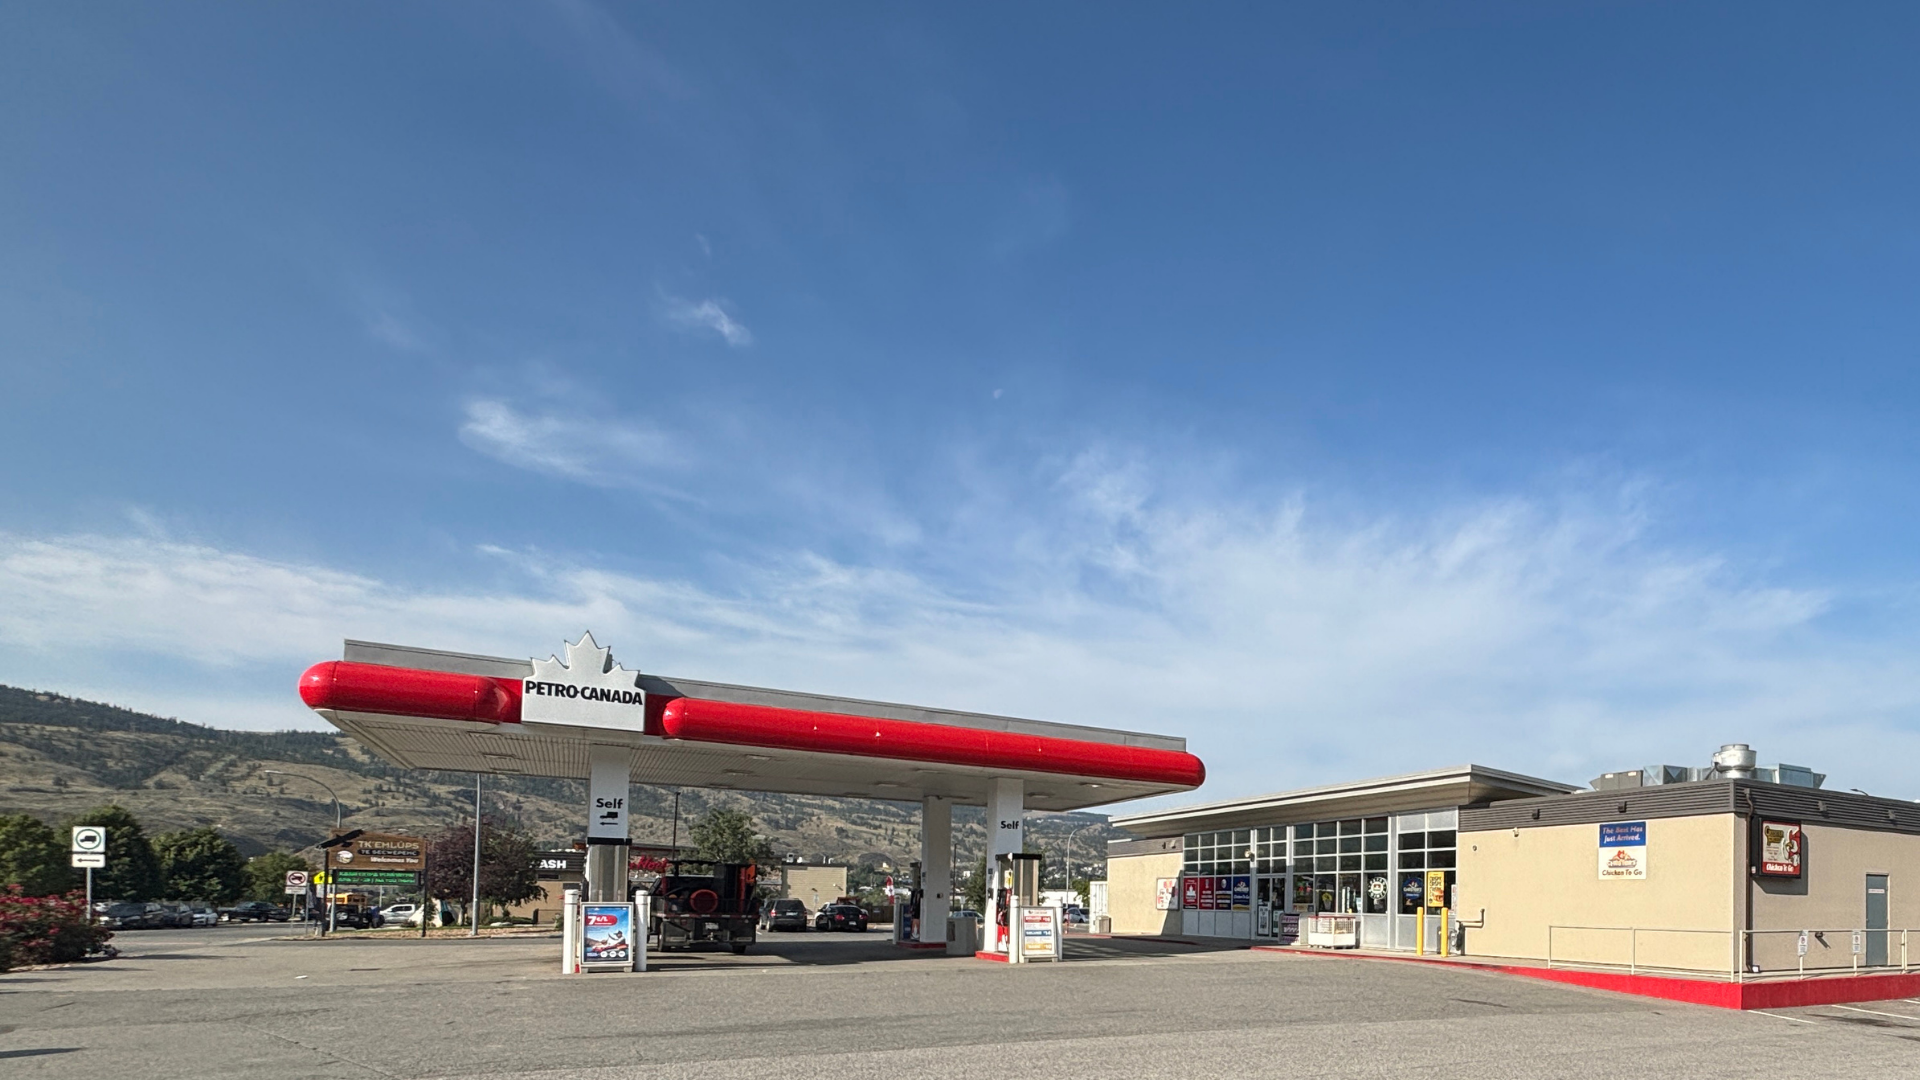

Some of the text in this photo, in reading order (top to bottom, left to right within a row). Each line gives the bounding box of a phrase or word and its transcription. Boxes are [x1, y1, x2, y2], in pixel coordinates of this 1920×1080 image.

[525, 680, 643, 705] PETRO-CANADA
[596, 798, 623, 809] Self
[1000, 820, 1019, 829] Self
[536, 860, 567, 869] ASH
[1633, 868, 1642, 876] Go
